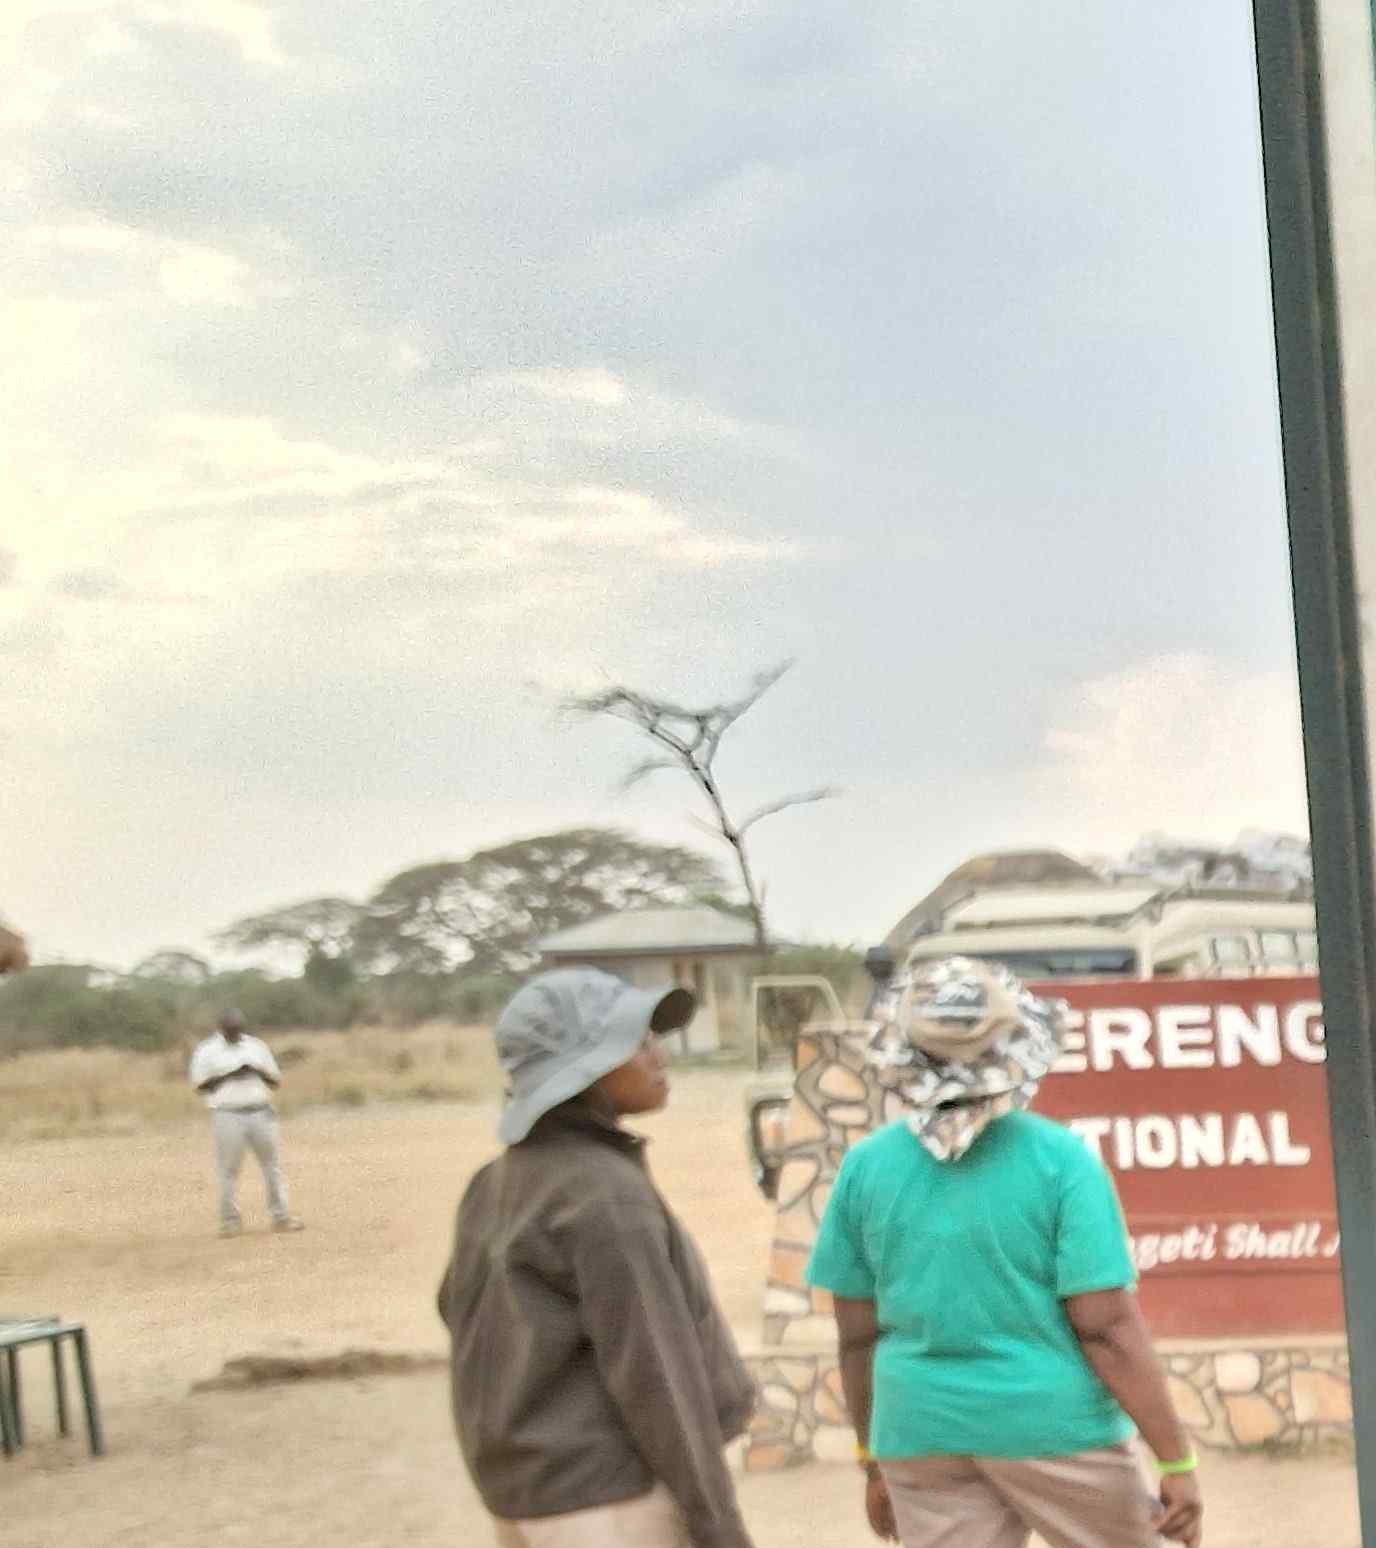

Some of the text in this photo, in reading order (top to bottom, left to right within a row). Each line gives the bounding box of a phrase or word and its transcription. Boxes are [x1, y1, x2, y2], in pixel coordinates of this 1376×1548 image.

[1048, 1001, 1327, 1072] ERENG
[1071, 1110, 1311, 1170] TIONAL
[1225, 1221, 1322, 1261] Shall
